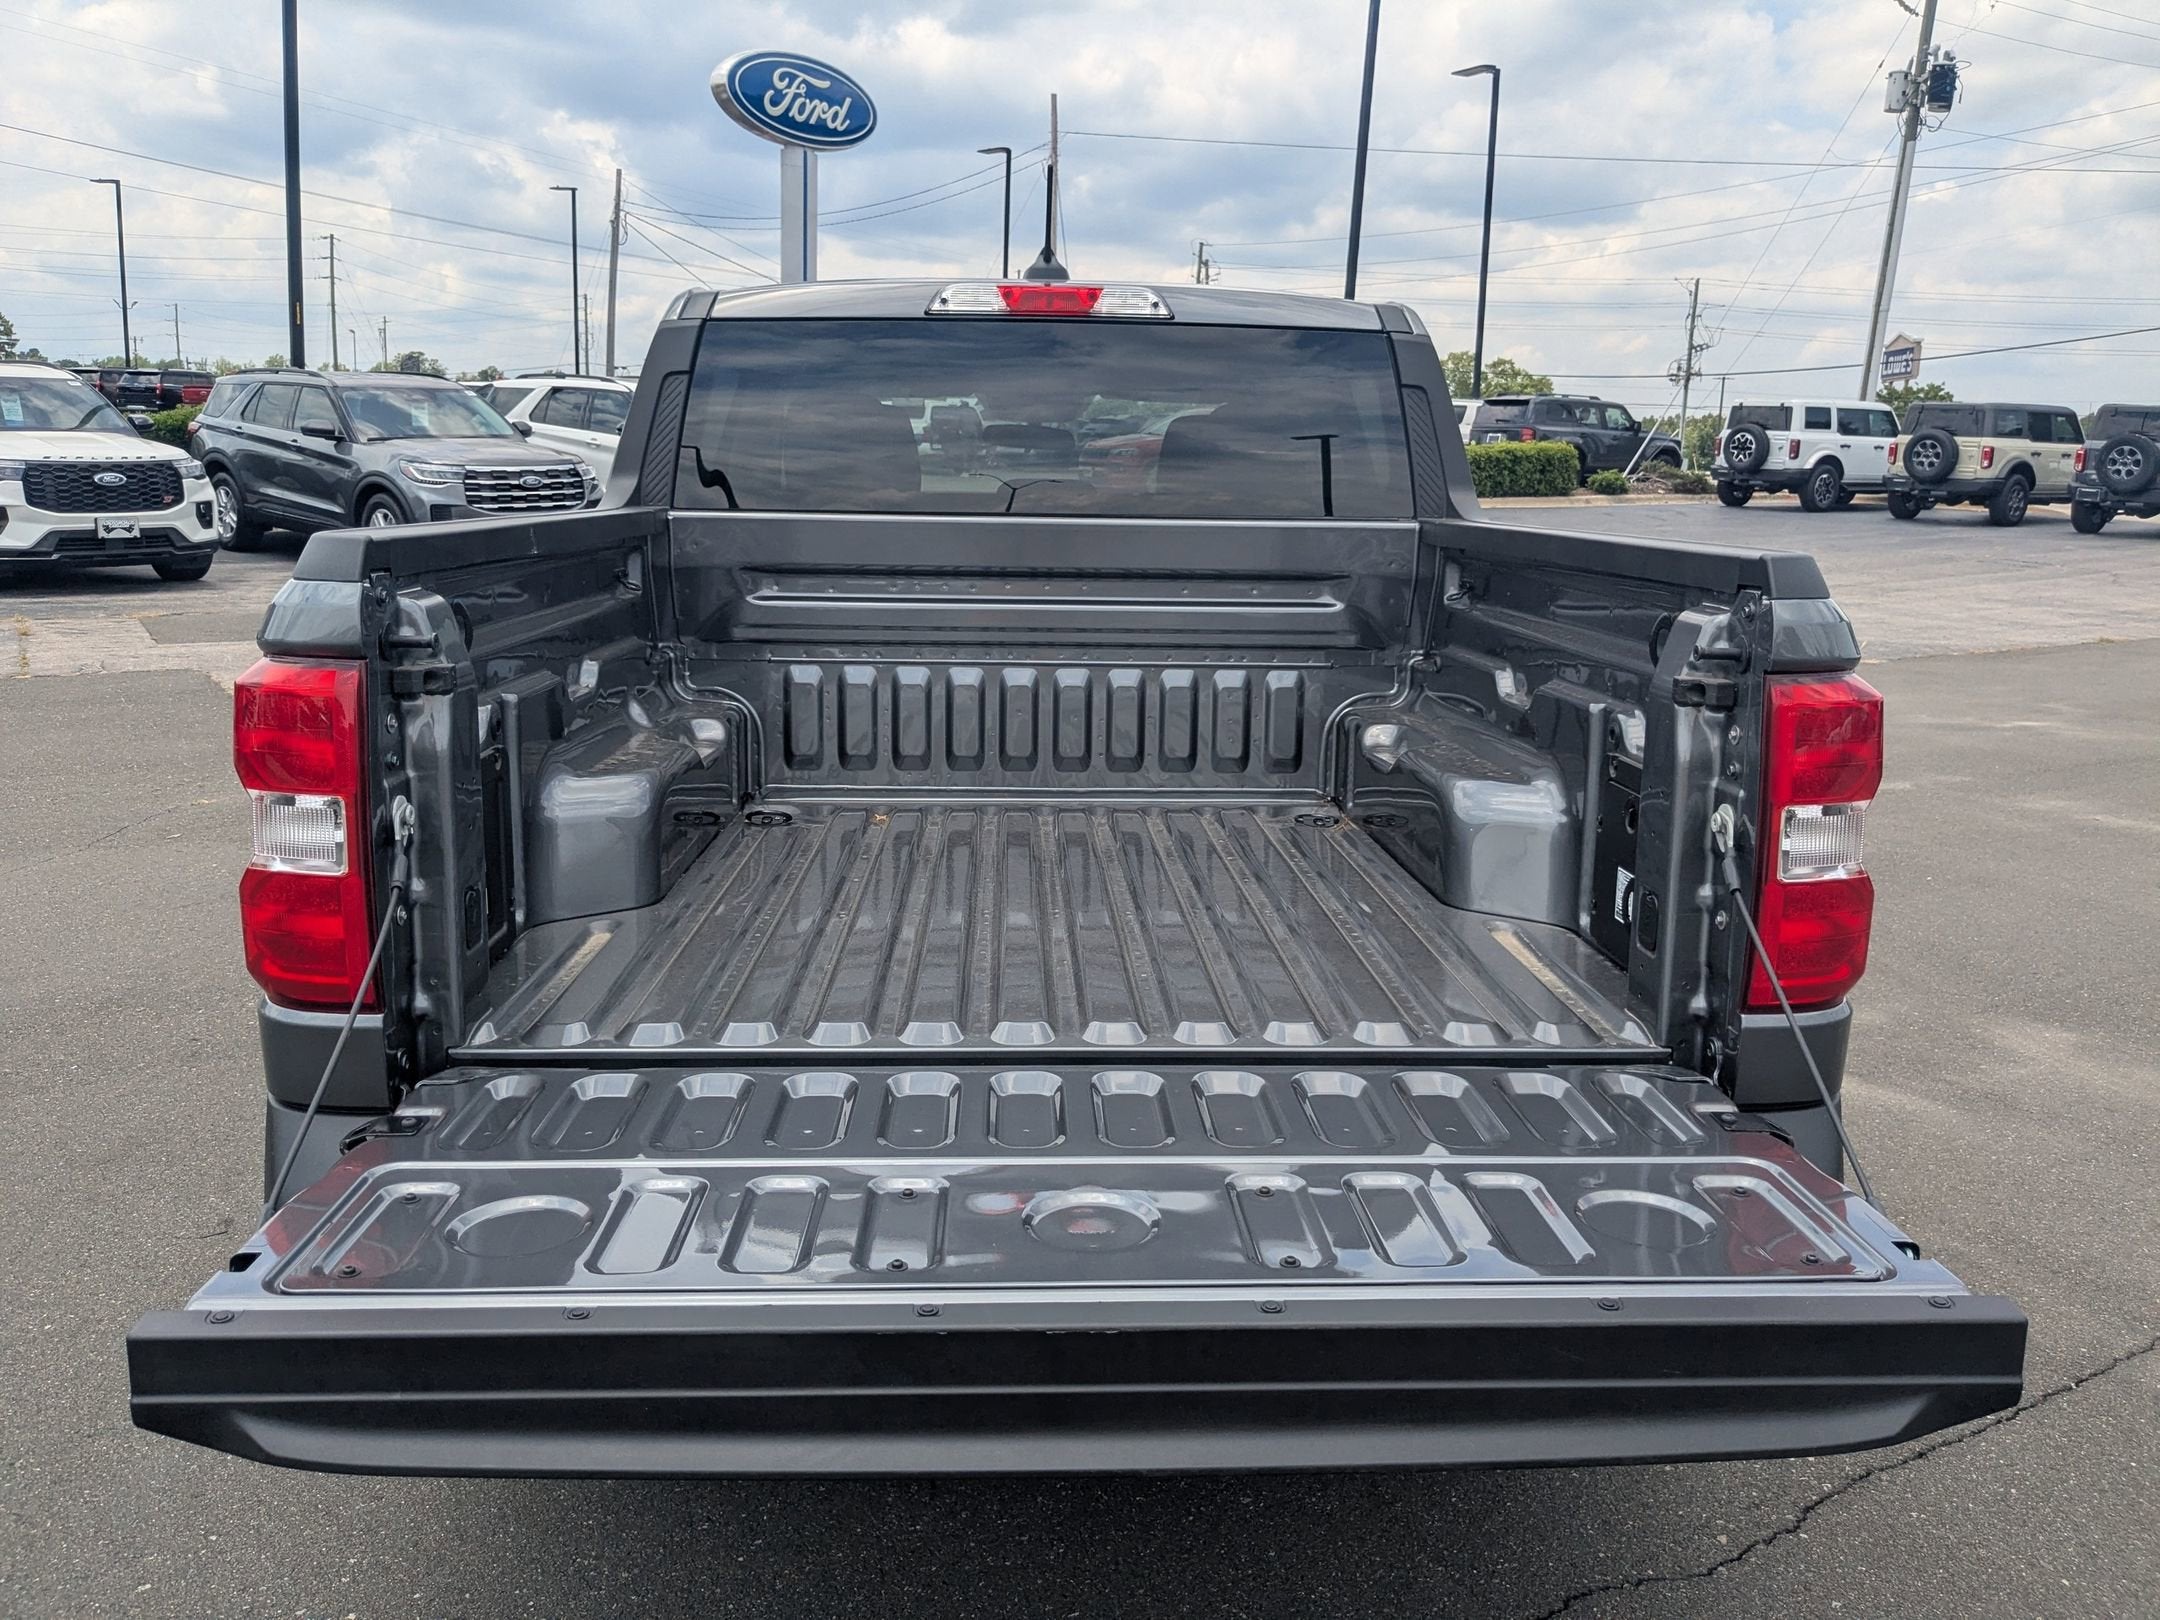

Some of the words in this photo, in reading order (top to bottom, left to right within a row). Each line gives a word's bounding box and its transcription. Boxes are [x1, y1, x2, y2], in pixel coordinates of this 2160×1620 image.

[763, 67, 851, 131] Ford
[1882, 350, 1913, 375] LOWE'S
[102, 475, 120, 483] Ford
